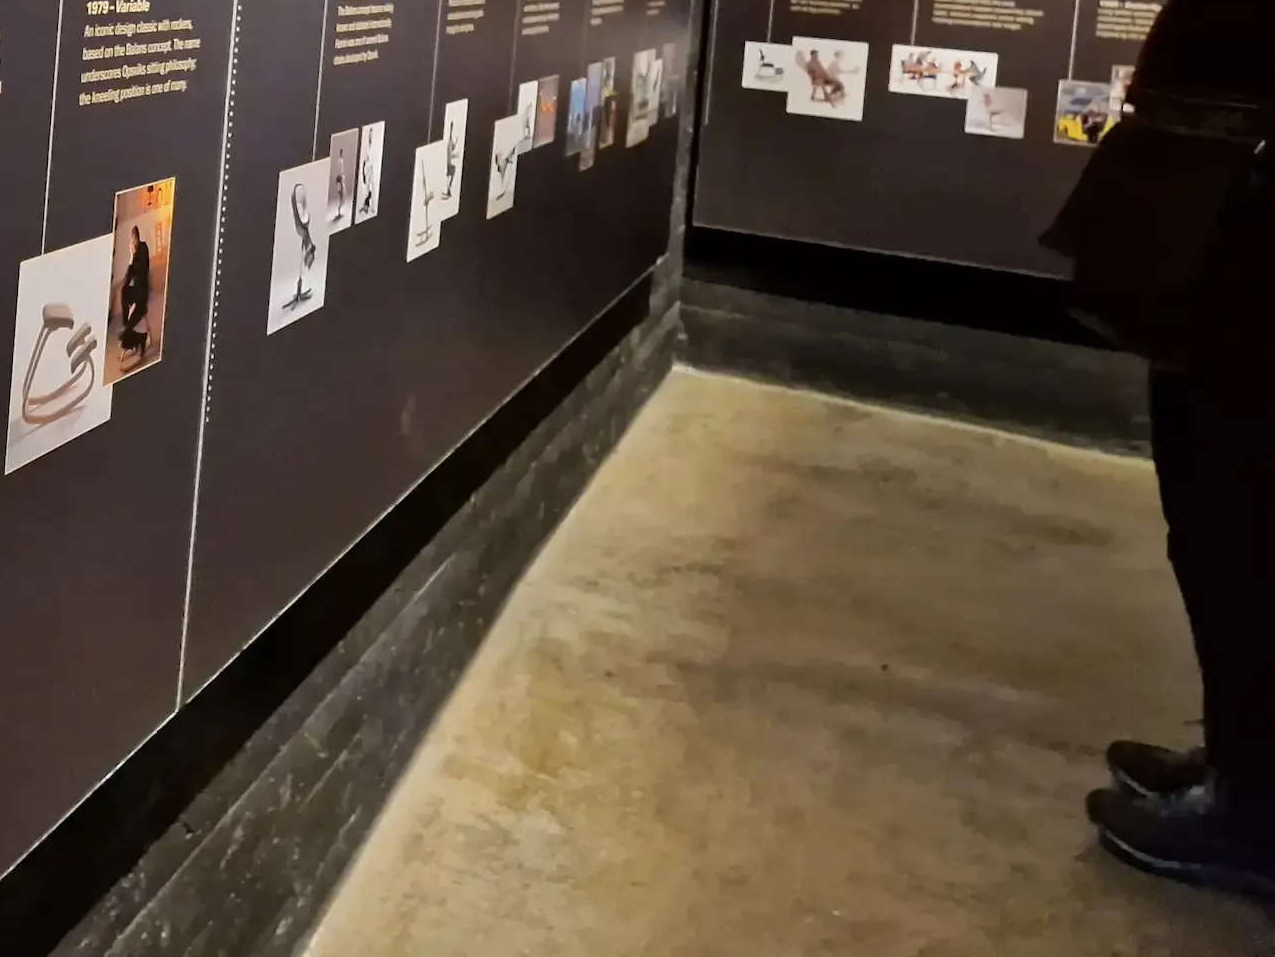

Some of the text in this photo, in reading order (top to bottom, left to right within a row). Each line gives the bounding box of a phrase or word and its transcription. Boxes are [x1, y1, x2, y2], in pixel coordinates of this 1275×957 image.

[87, 0, 150, 14] 1979 Variable
[84, 21, 157, 37] An iconic design classic
[83, 39, 200, 60] based on the Balans The name
[81, 69, 121, 83] underscores
[79, 81, 170, 105] the kneeling position is one of
